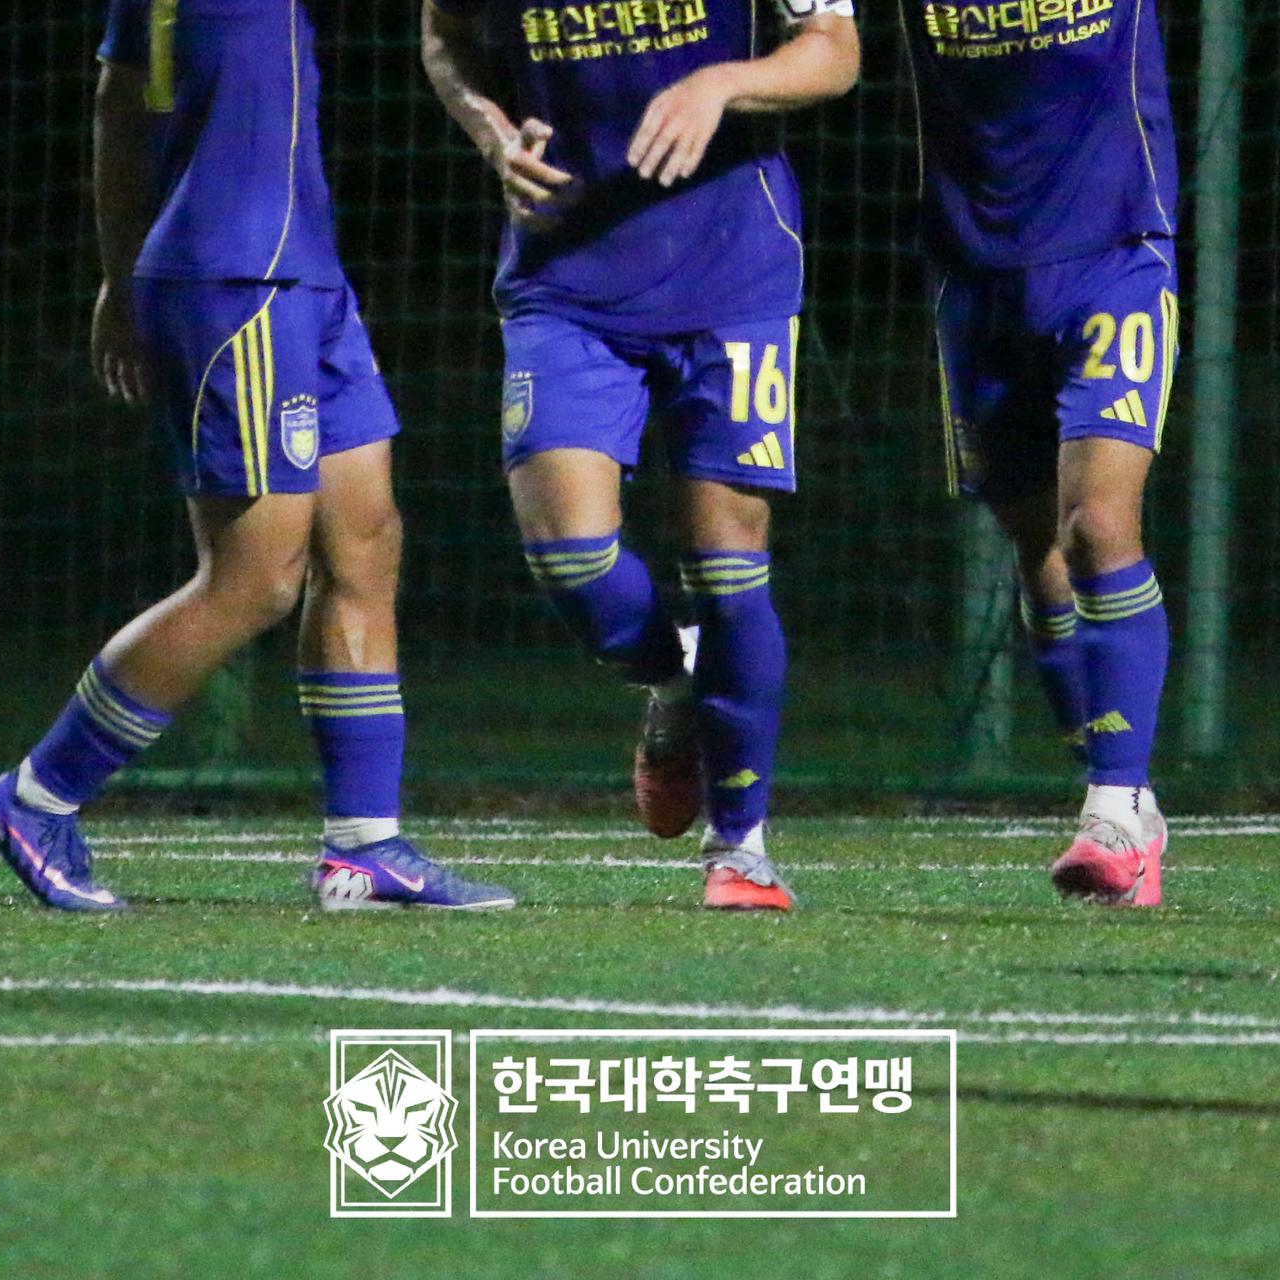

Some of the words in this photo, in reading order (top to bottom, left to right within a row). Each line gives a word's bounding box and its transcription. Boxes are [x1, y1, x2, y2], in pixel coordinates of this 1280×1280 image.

[1030, 34, 1054, 51] OF
[1058, 18, 1111, 45] ULSAN
[724, 342, 787, 425] 16
[1082, 311, 1155, 384] 20
